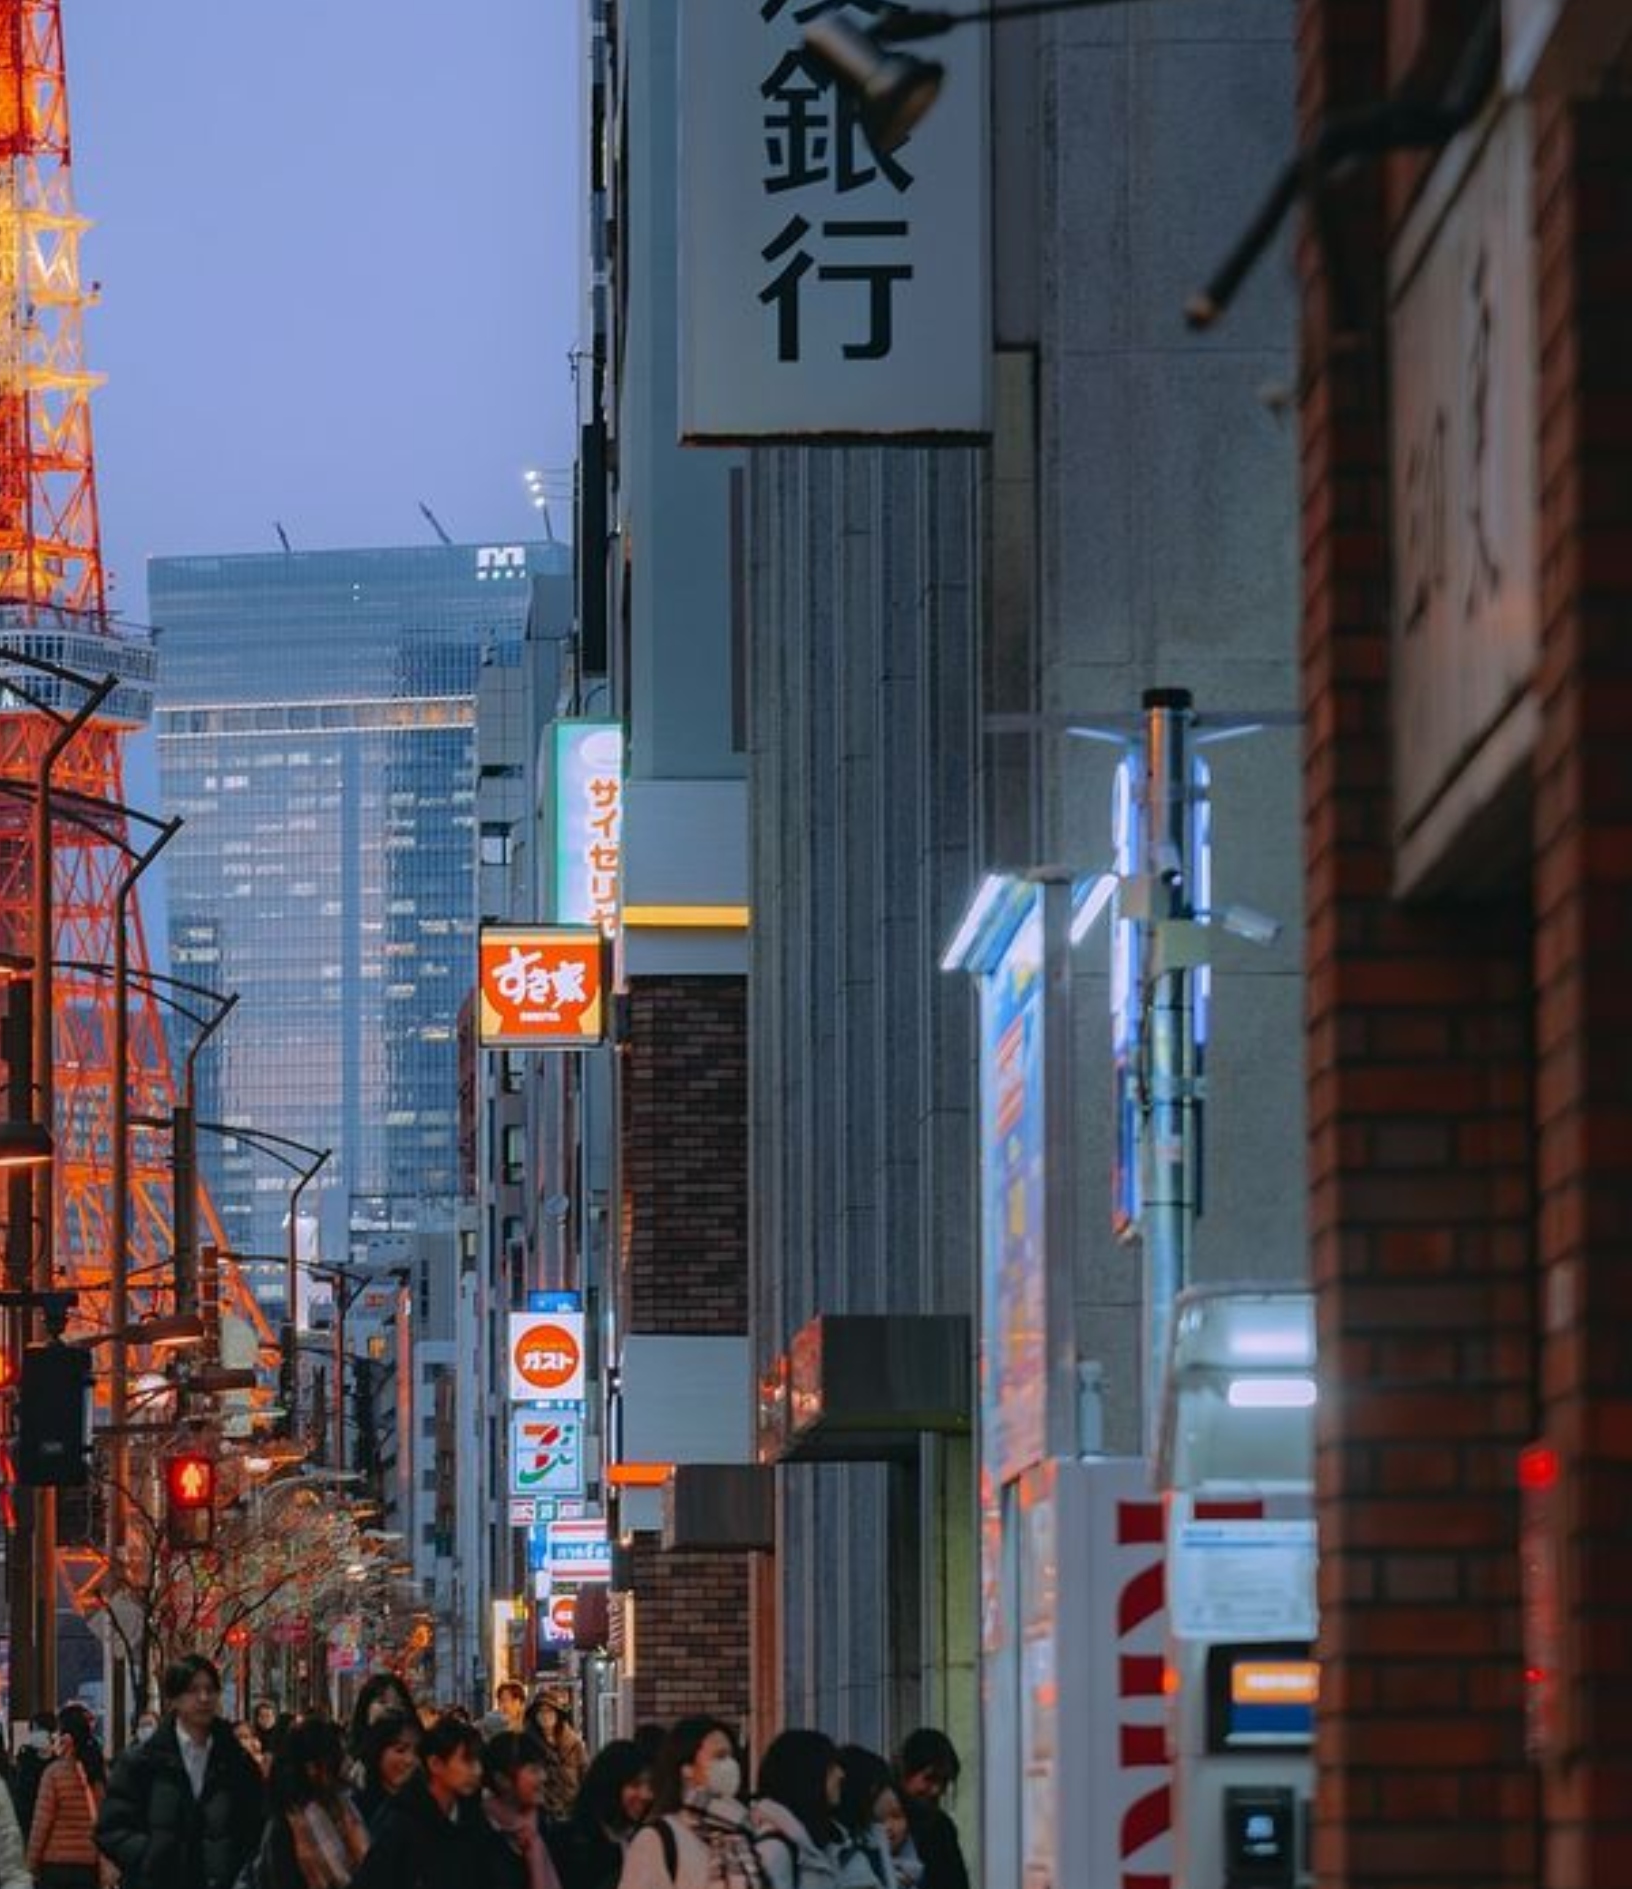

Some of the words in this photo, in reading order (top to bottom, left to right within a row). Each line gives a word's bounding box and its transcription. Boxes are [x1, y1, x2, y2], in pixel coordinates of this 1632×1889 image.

[758, 0, 915, 362] 銀行
[491, 946, 587, 1010] すき家
